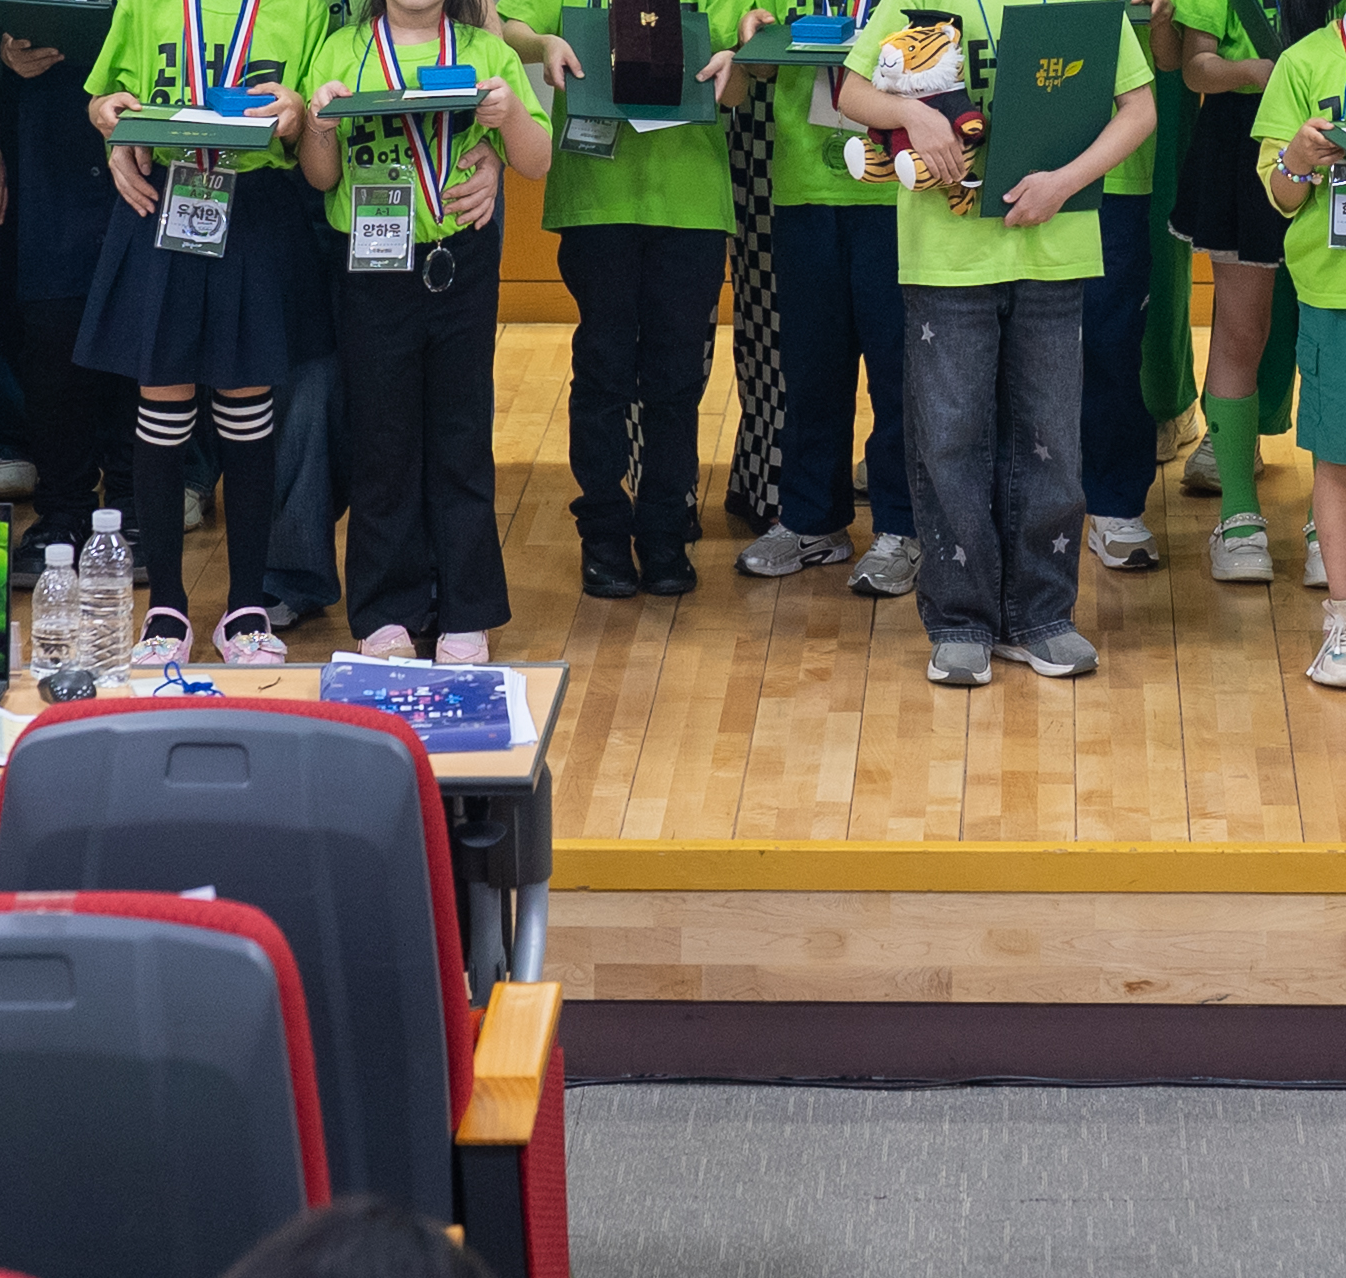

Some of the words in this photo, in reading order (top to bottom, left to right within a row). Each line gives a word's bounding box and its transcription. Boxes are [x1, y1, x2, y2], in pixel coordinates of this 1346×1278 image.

[1036, 58, 1063, 87] 공터
[1046, 78, 1061, 92] 영어
[209, 175, 223, 189] 10
[388, 190, 401, 204] 10
[363, 223, 401, 237] 양하윤
